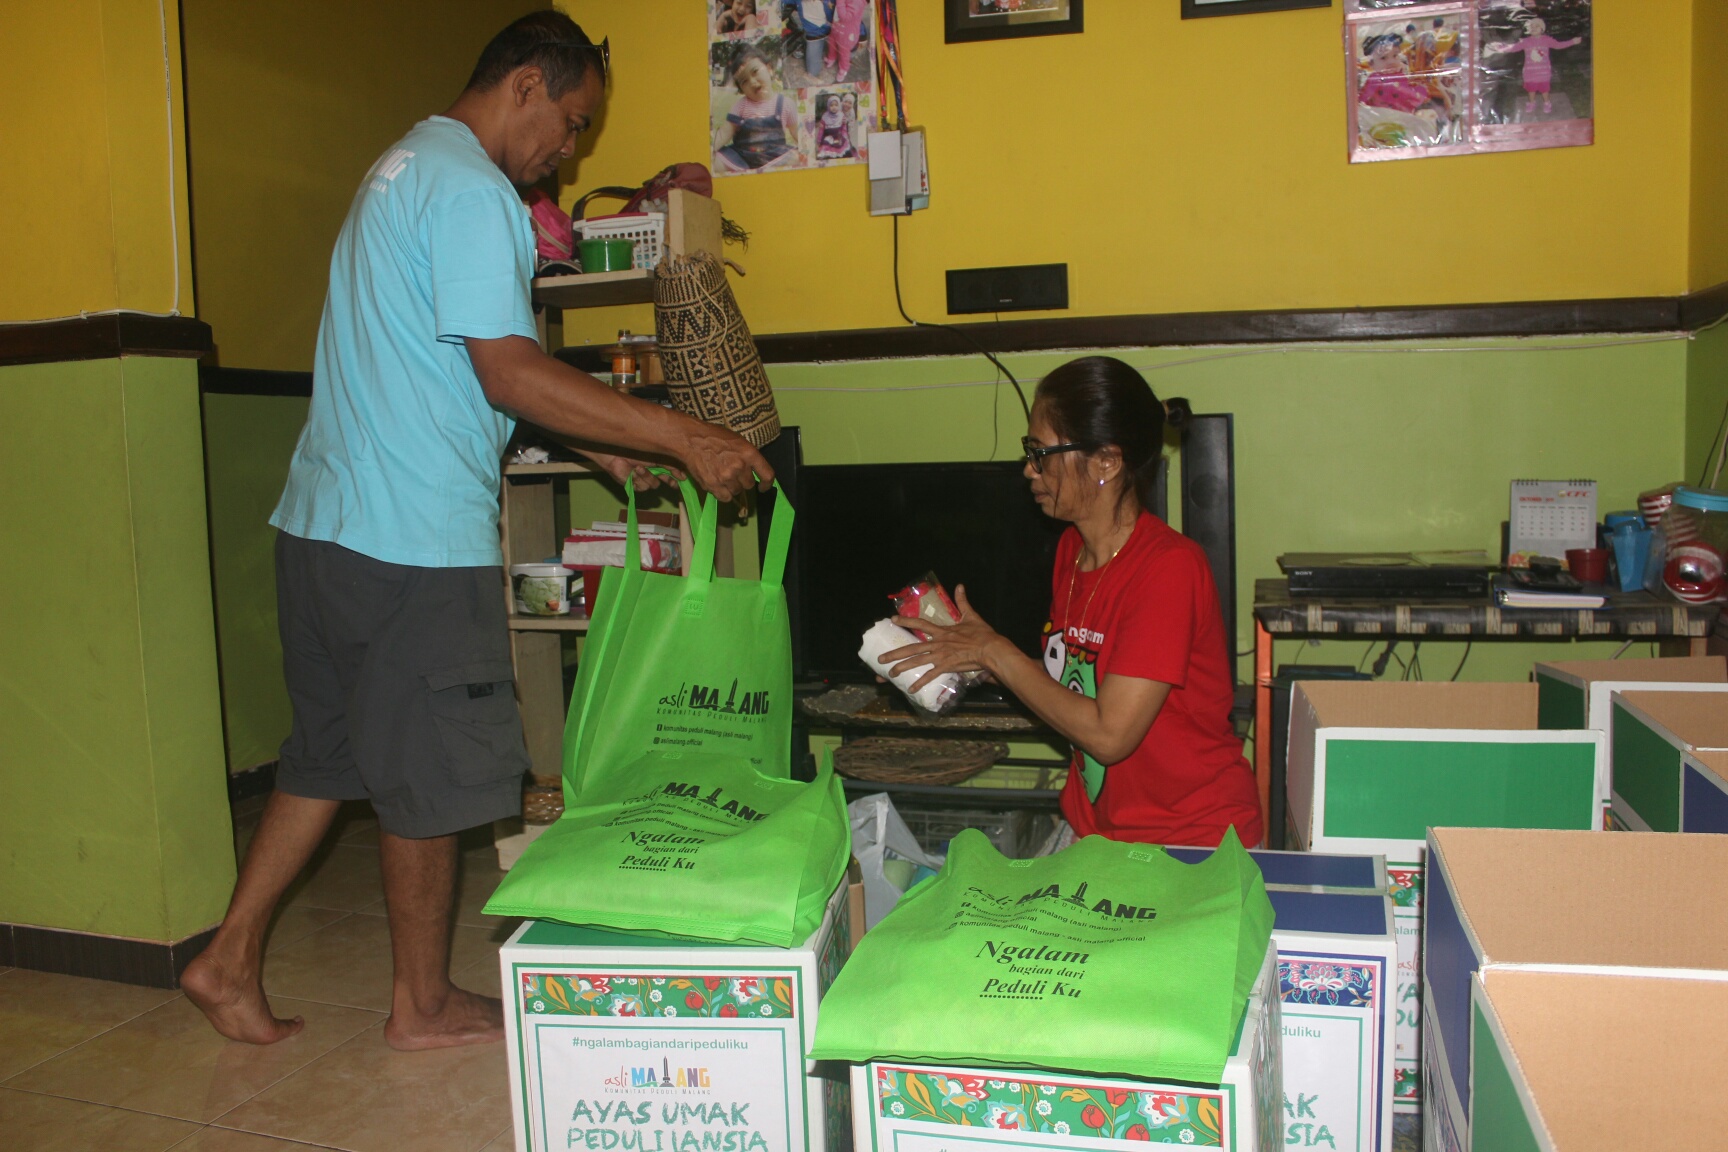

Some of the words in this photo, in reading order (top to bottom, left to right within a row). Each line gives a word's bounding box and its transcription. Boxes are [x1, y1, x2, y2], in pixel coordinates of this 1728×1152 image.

[620, 830, 706, 847] Ngalam
[643, 846, 676, 855] bagian
[621, 855, 671, 868] Peduli
[672, 858, 696, 870] Ku
[975, 940, 1090, 964] Ngalam
[1009, 963, 1053, 976] bagian
[1056, 965, 1086, 980] dari
[982, 978, 1049, 995] Peduli
[1051, 981, 1082, 998] Ku
[572, 1036, 748, 1051] #ngalambagiandaripeduliku
[604, 1065, 629, 1088] asli
[571, 1098, 654, 1126] AYAS
[662, 1100, 751, 1128] UMAK
[566, 1126, 665, 1152] PEDULI
